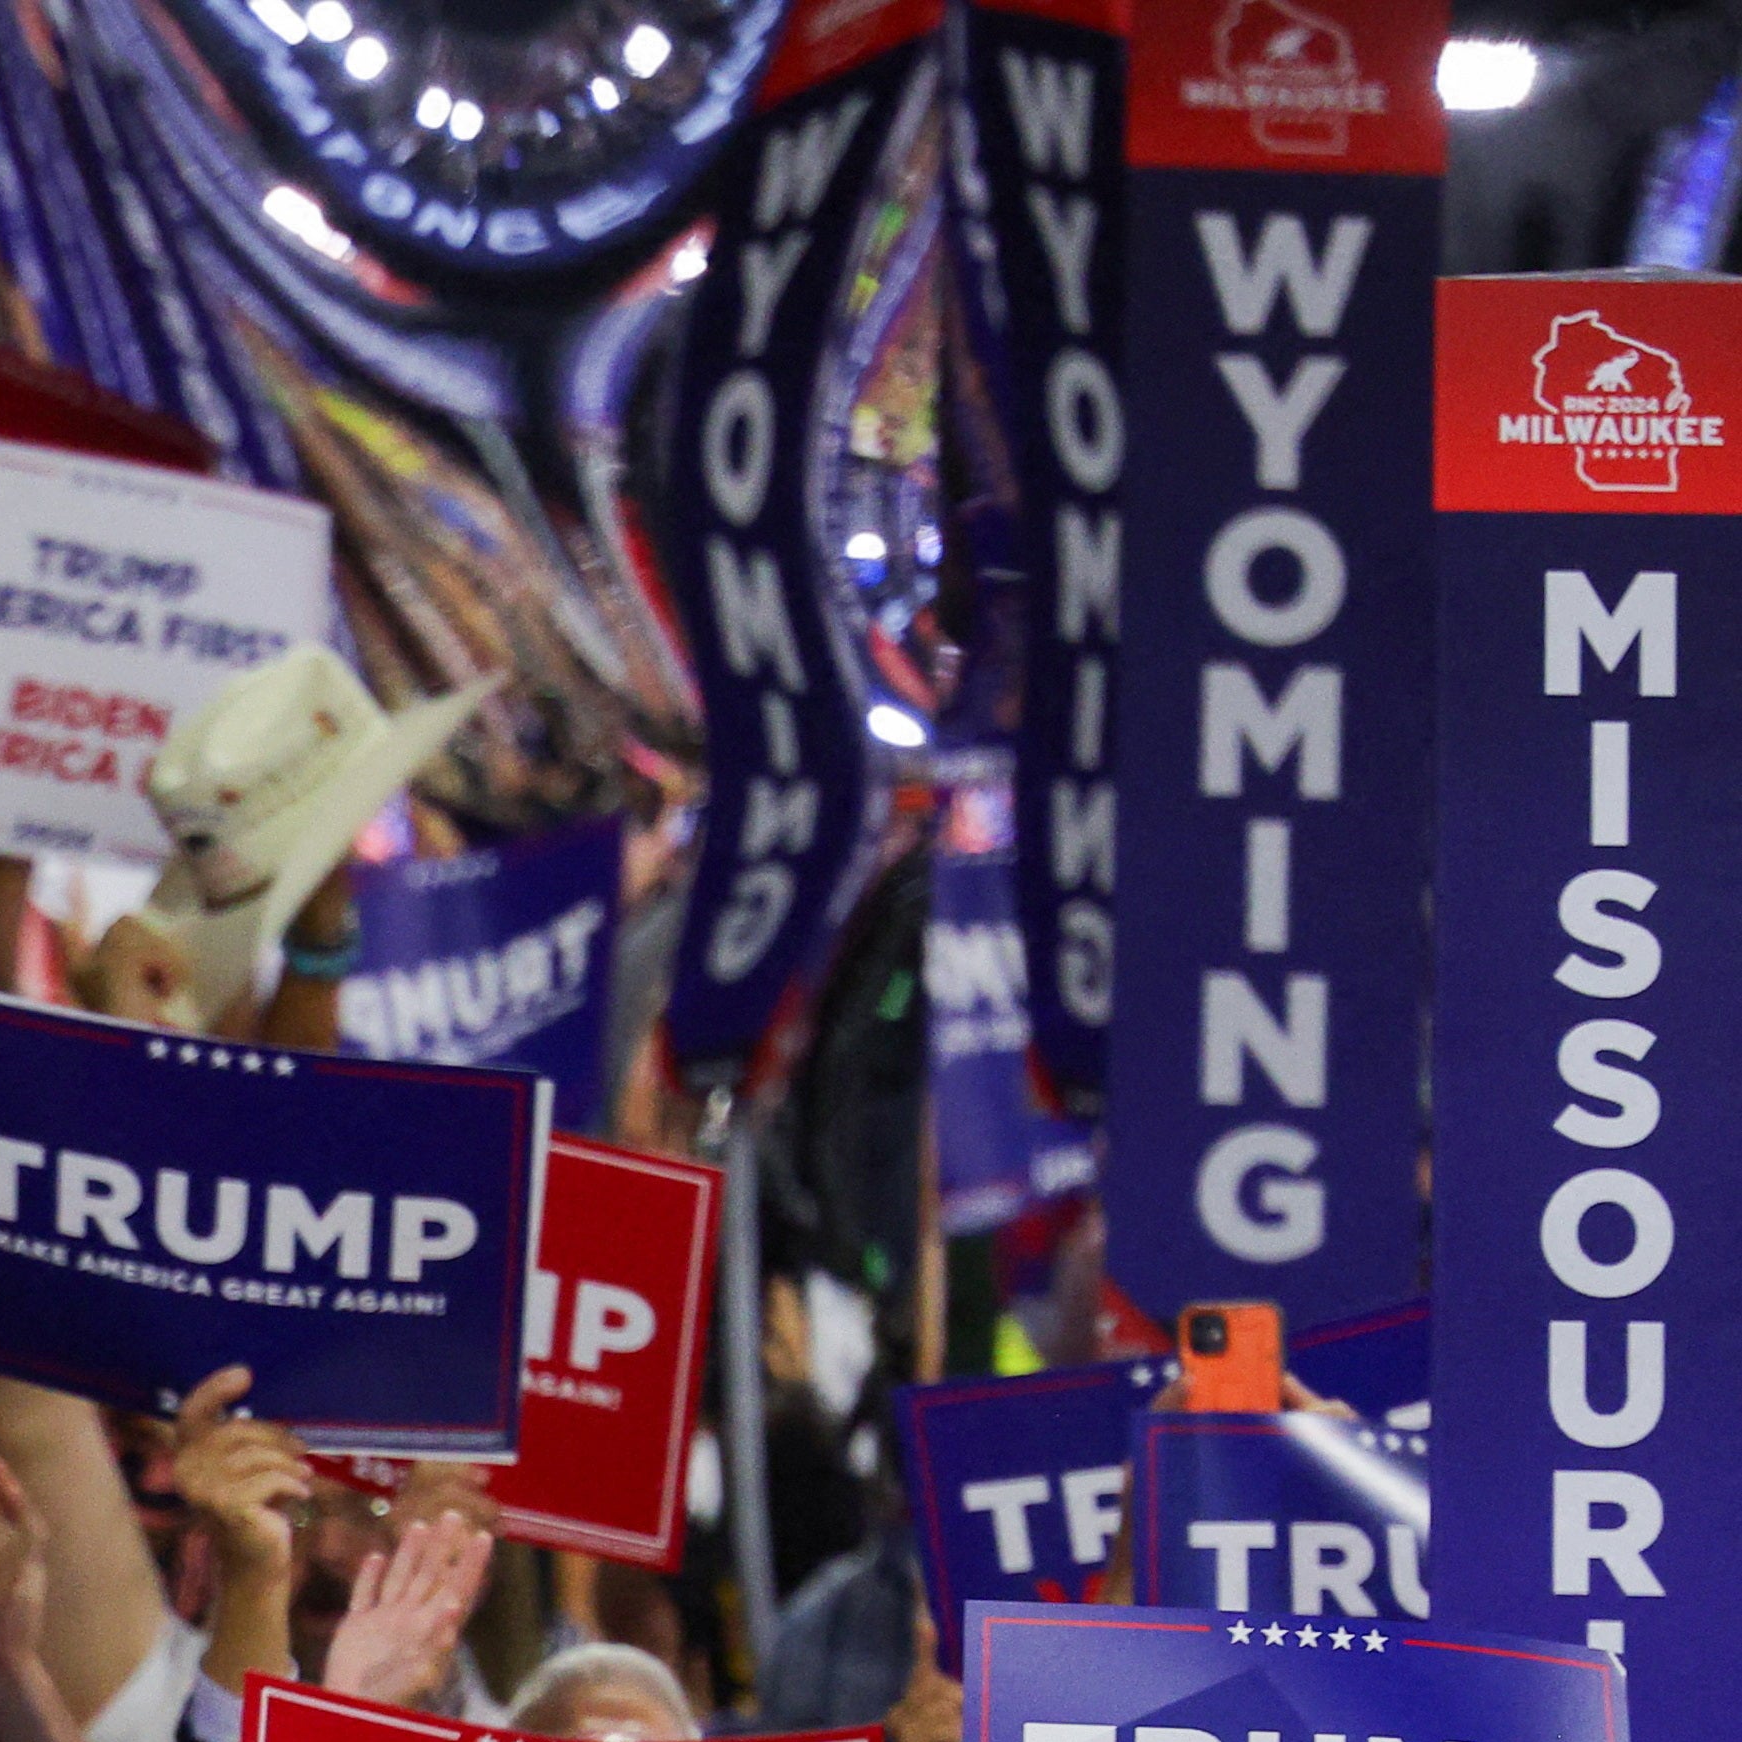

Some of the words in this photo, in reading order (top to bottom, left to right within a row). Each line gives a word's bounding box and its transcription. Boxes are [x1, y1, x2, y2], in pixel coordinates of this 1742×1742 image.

[1499, 414, 1724, 446] MILWAUKEE
[35, 533, 199, 597] TRUMP
[10, 676, 174, 743] BIDEN
[1192, 213, 1374, 1264] WYOMING
[77, 1252, 211, 1300] AMERICA
[220, 1277, 325, 1311] GREAT
[334, 1287, 447, 1318] AGAIN!
